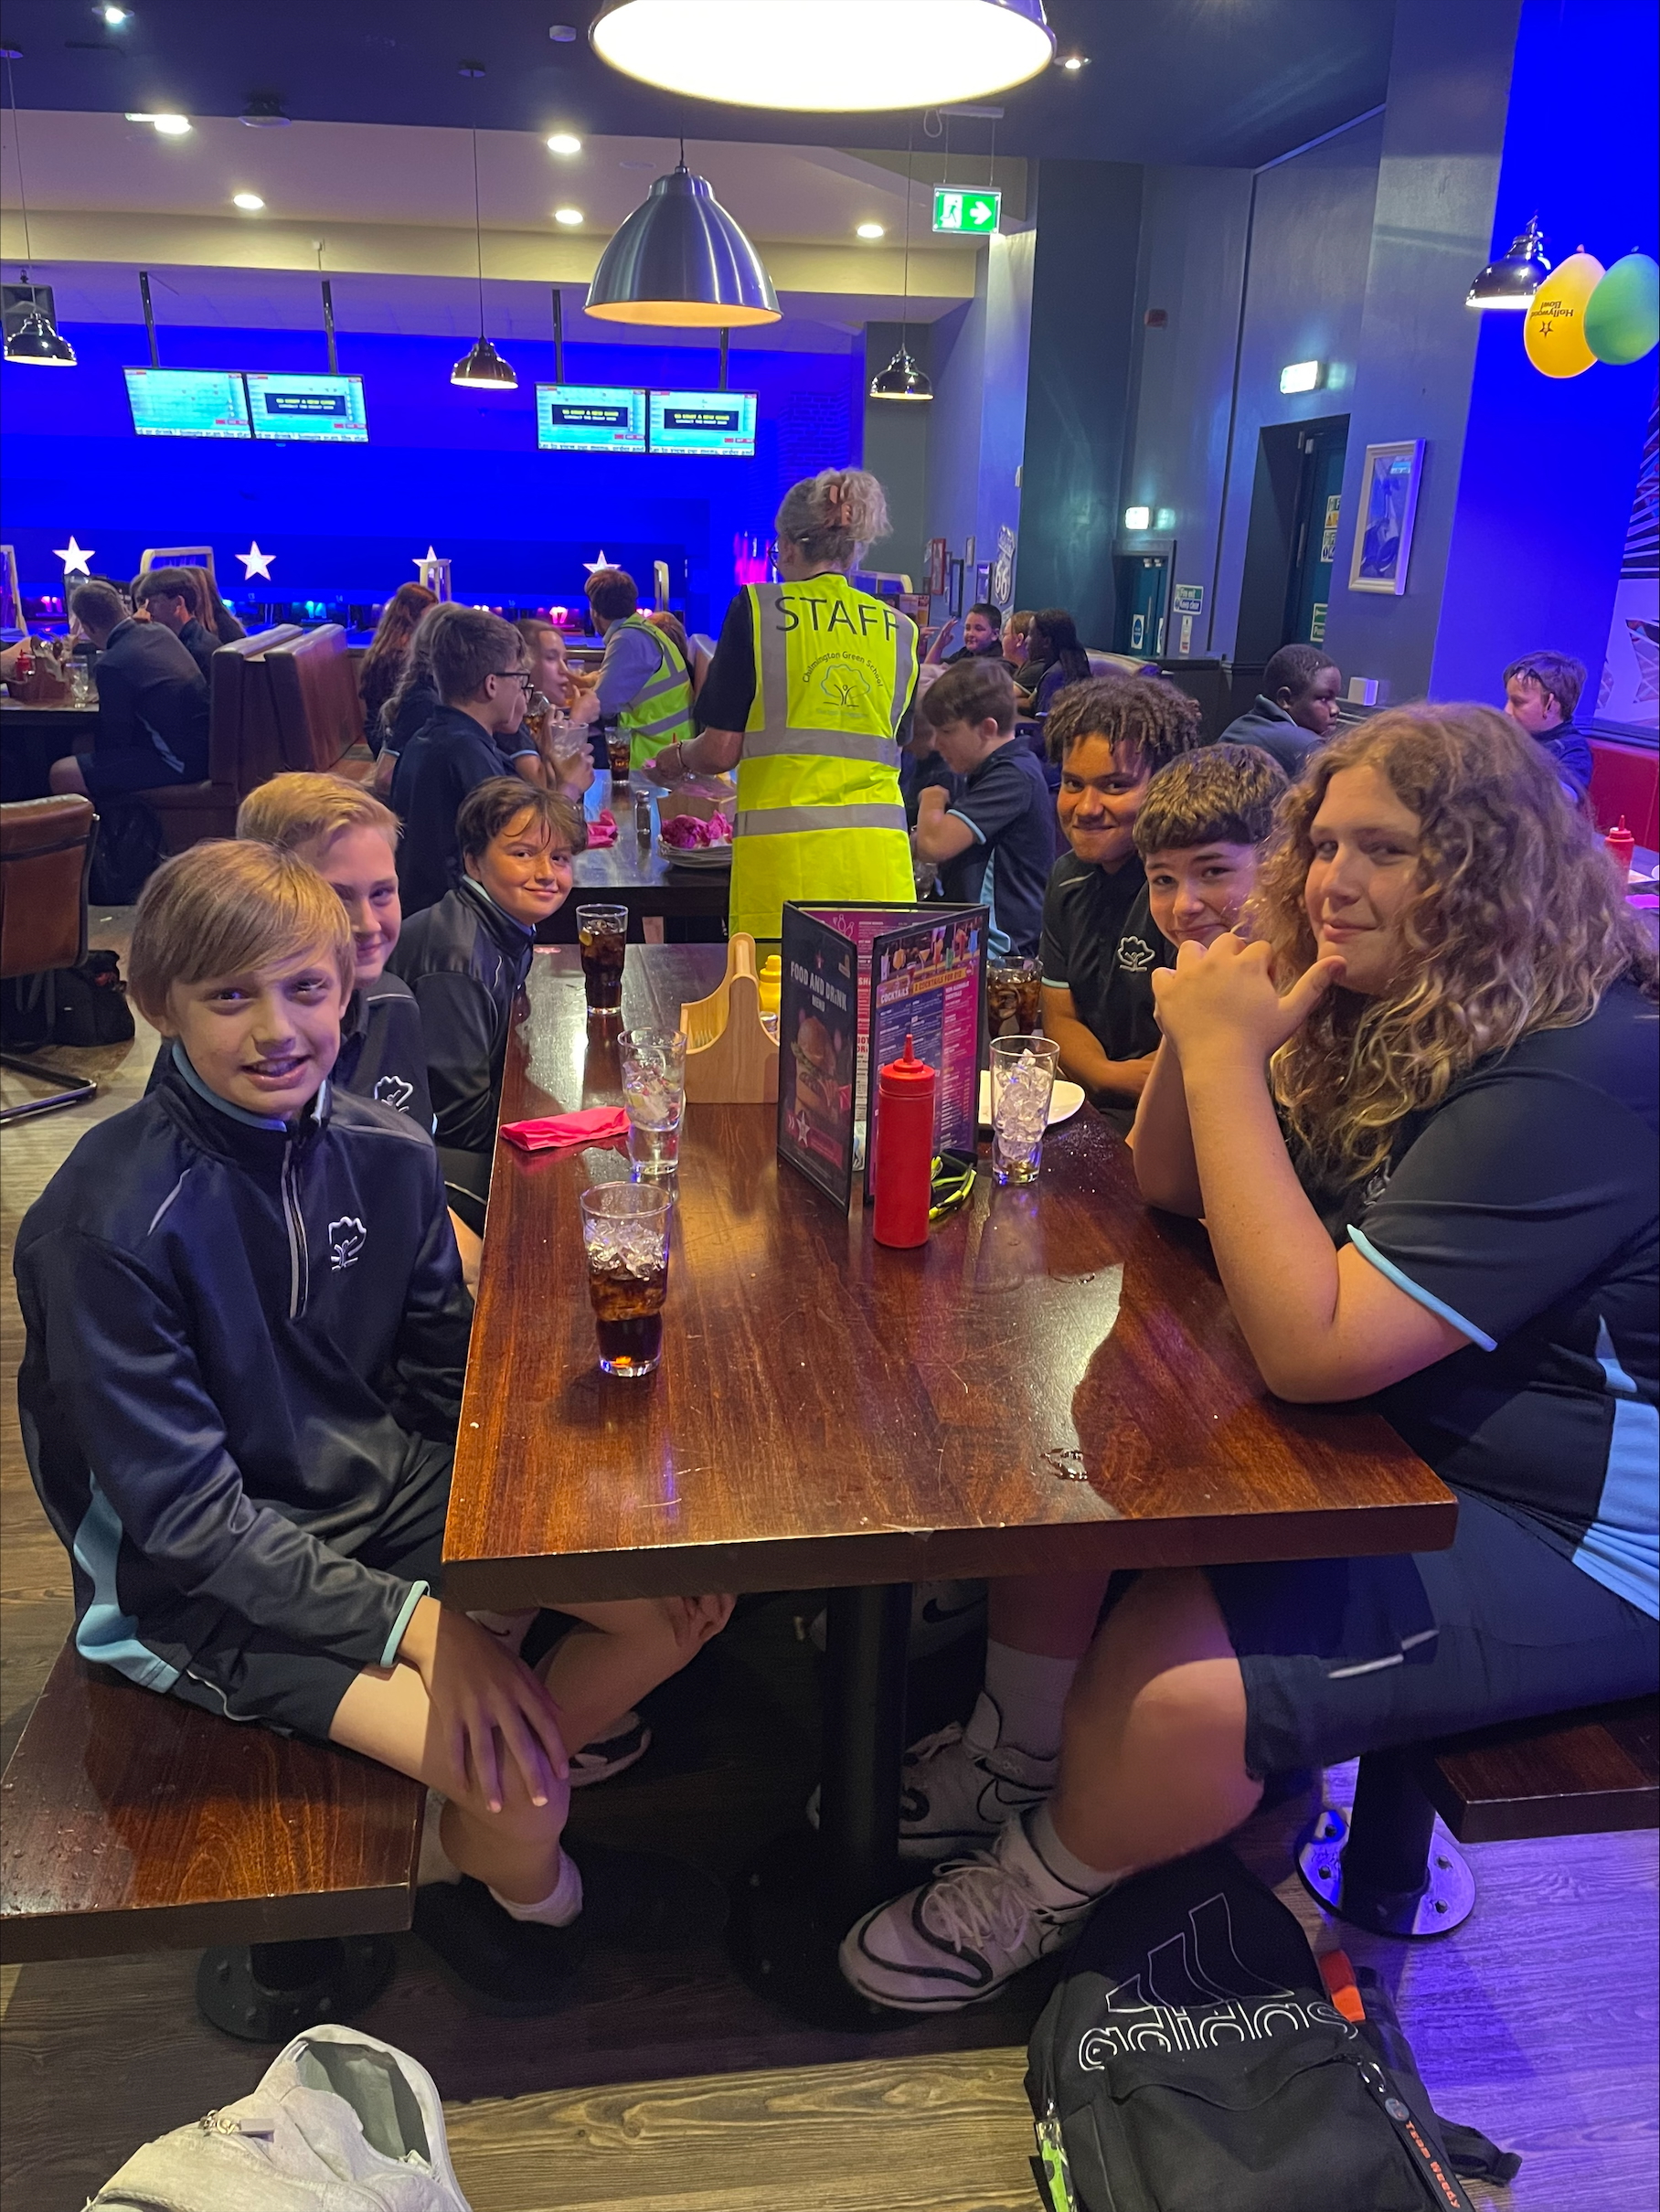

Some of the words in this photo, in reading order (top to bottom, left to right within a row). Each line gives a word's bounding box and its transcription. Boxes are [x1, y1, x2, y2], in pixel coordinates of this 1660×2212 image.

[1530, 308, 1574, 319] Hollywood
[1540, 301, 1562, 311] Bowl
[995, 559, 1010, 601] 66
[774, 596, 899, 641] STAFF
[802, 652, 841, 684] Chilmington
[842, 651, 866, 664] Green
[866, 659, 884, 687] School
[790, 961, 809, 986] FOOD
[809, 972, 825, 996] AND
[1078, 1997, 1359, 2071] adidas
